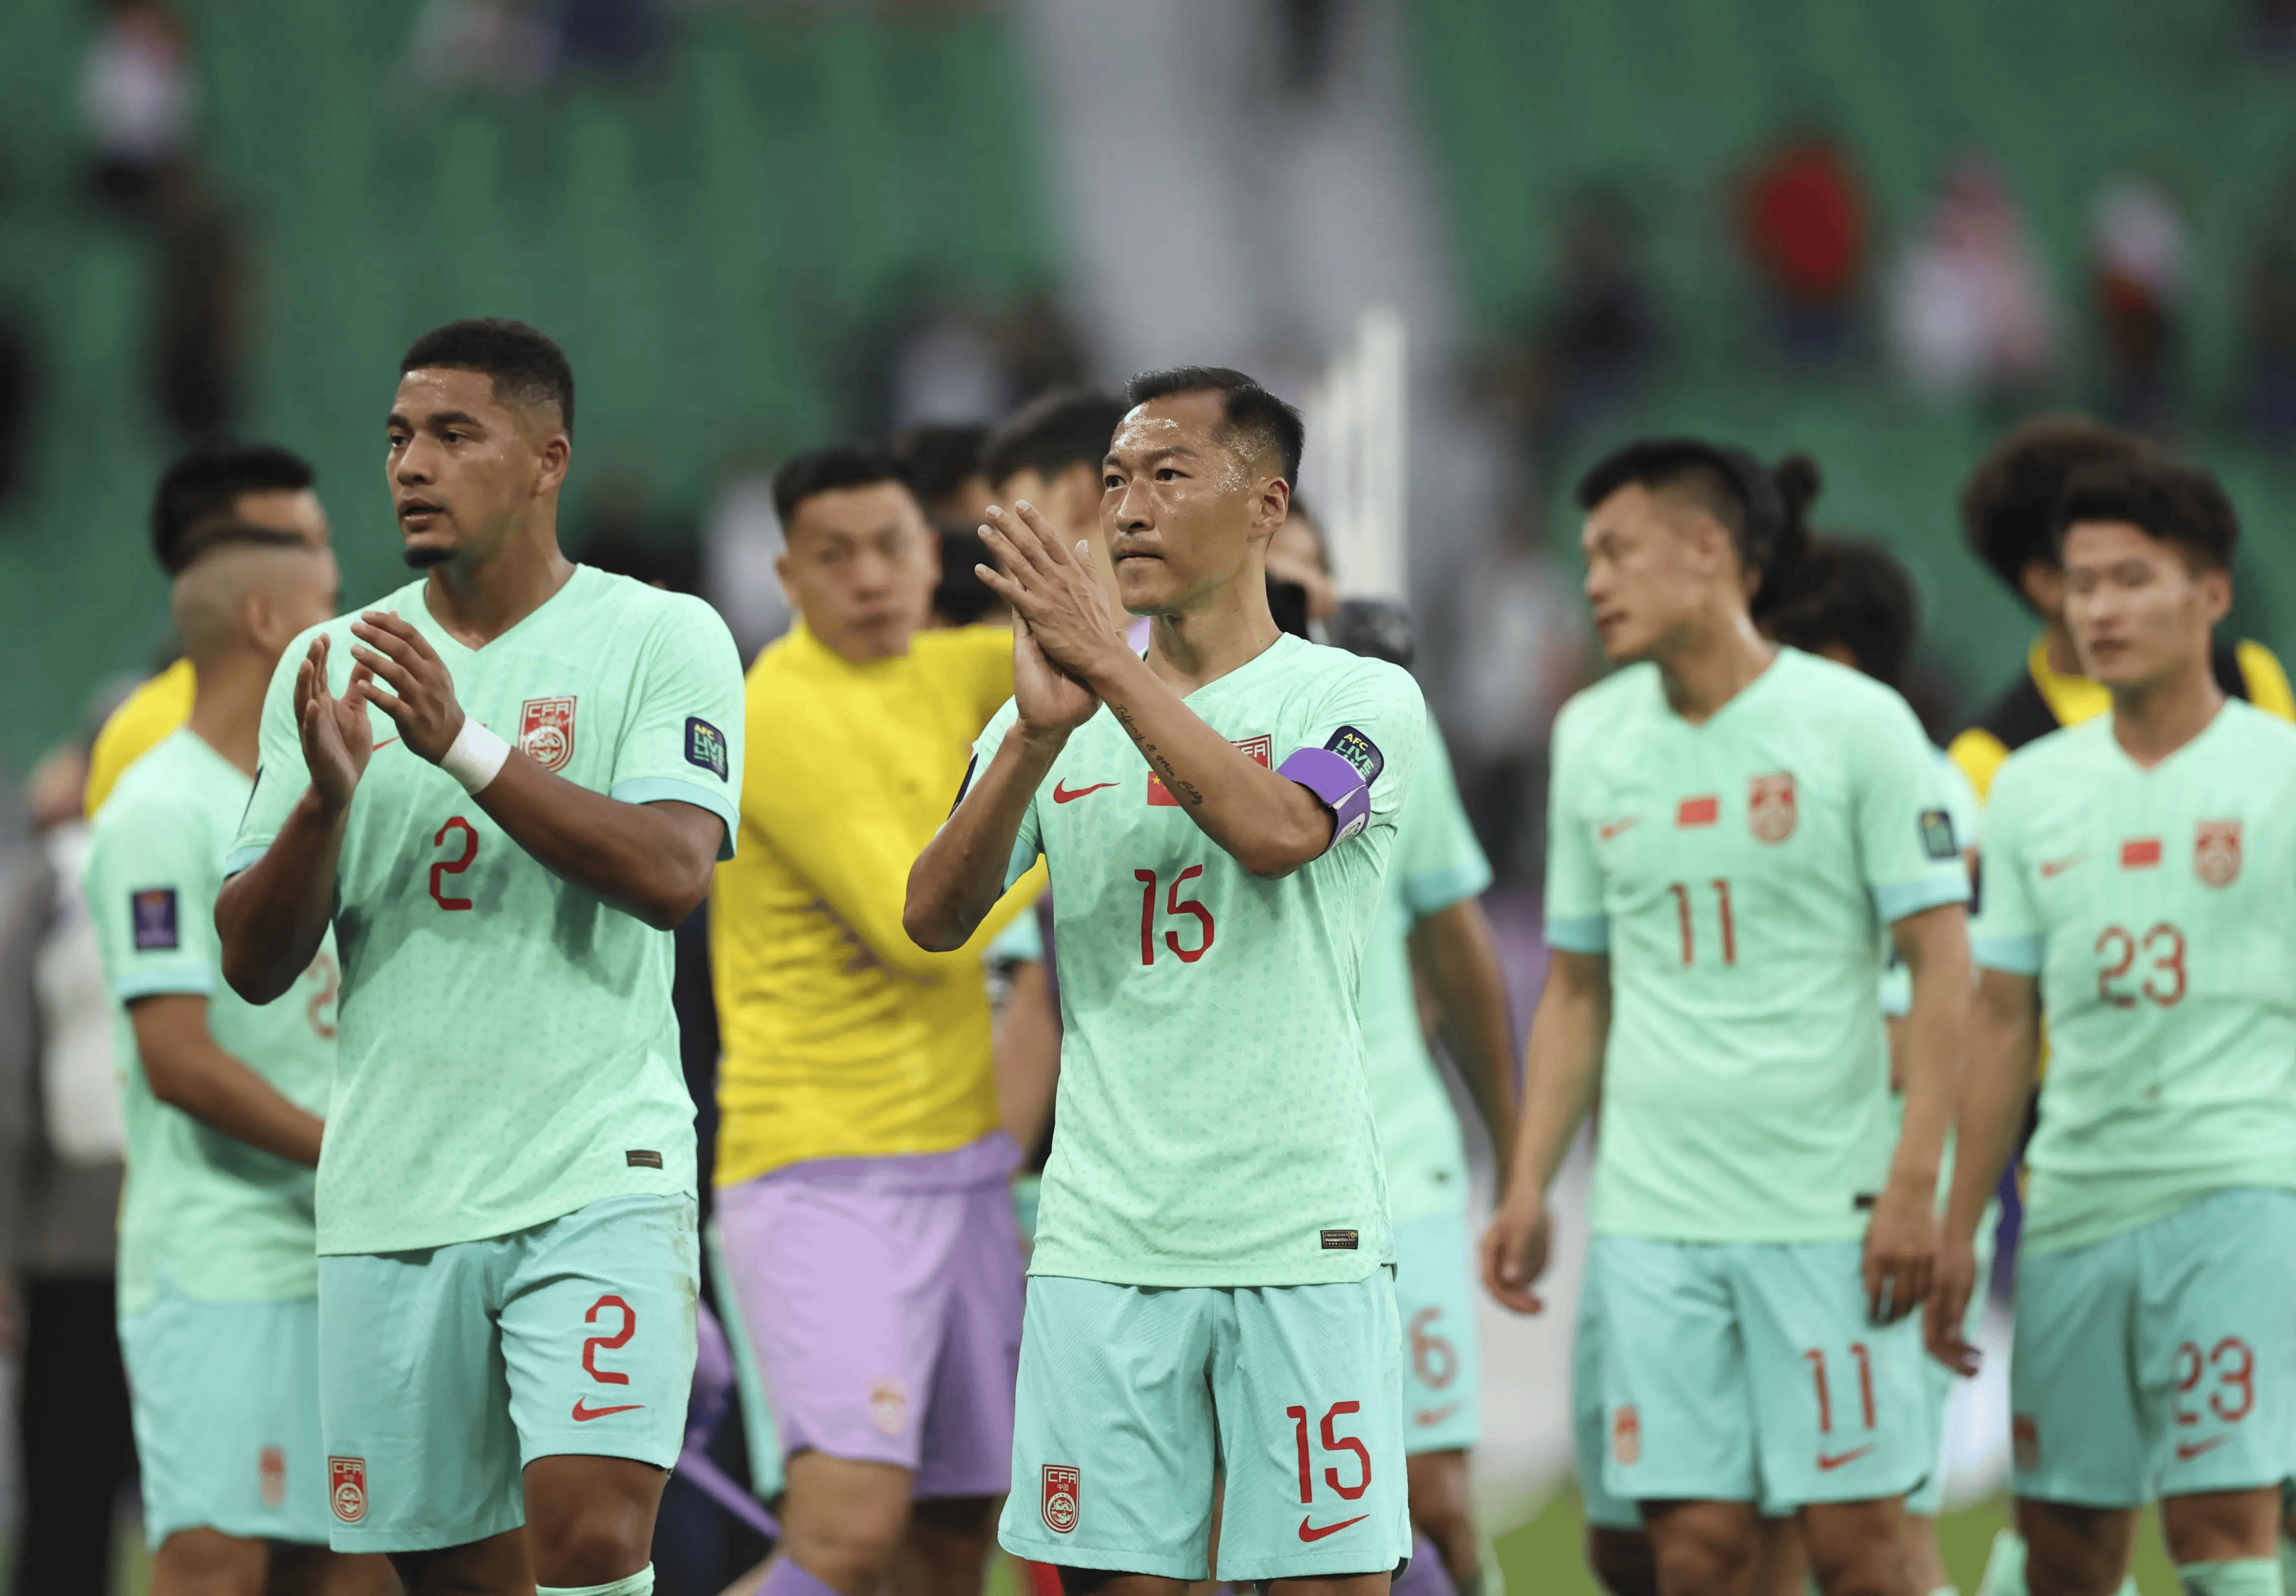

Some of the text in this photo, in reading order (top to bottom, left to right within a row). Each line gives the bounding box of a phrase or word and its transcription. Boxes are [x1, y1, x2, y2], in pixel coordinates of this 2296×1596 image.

[529, 703, 569, 718] CFA
[1241, 743, 1265, 758] FA
[1343, 733, 1369, 751] AFC
[1335, 739, 1374, 775] LIVE
[430, 816, 478, 911] 2
[1135, 864, 1215, 966] 15
[1671, 879, 1737, 966] 11
[2096, 922, 2187, 1008] 23
[582, 1294, 636, 1386] 2
[1408, 1306, 1460, 1391] 6
[2174, 1337, 2255, 1425] 23
[1804, 1342, 1876, 1434] 11
[333, 1462, 361, 1474] CFA
[1048, 1471, 1076, 1485] CFA
[1286, 1400, 1372, 1504] 15
